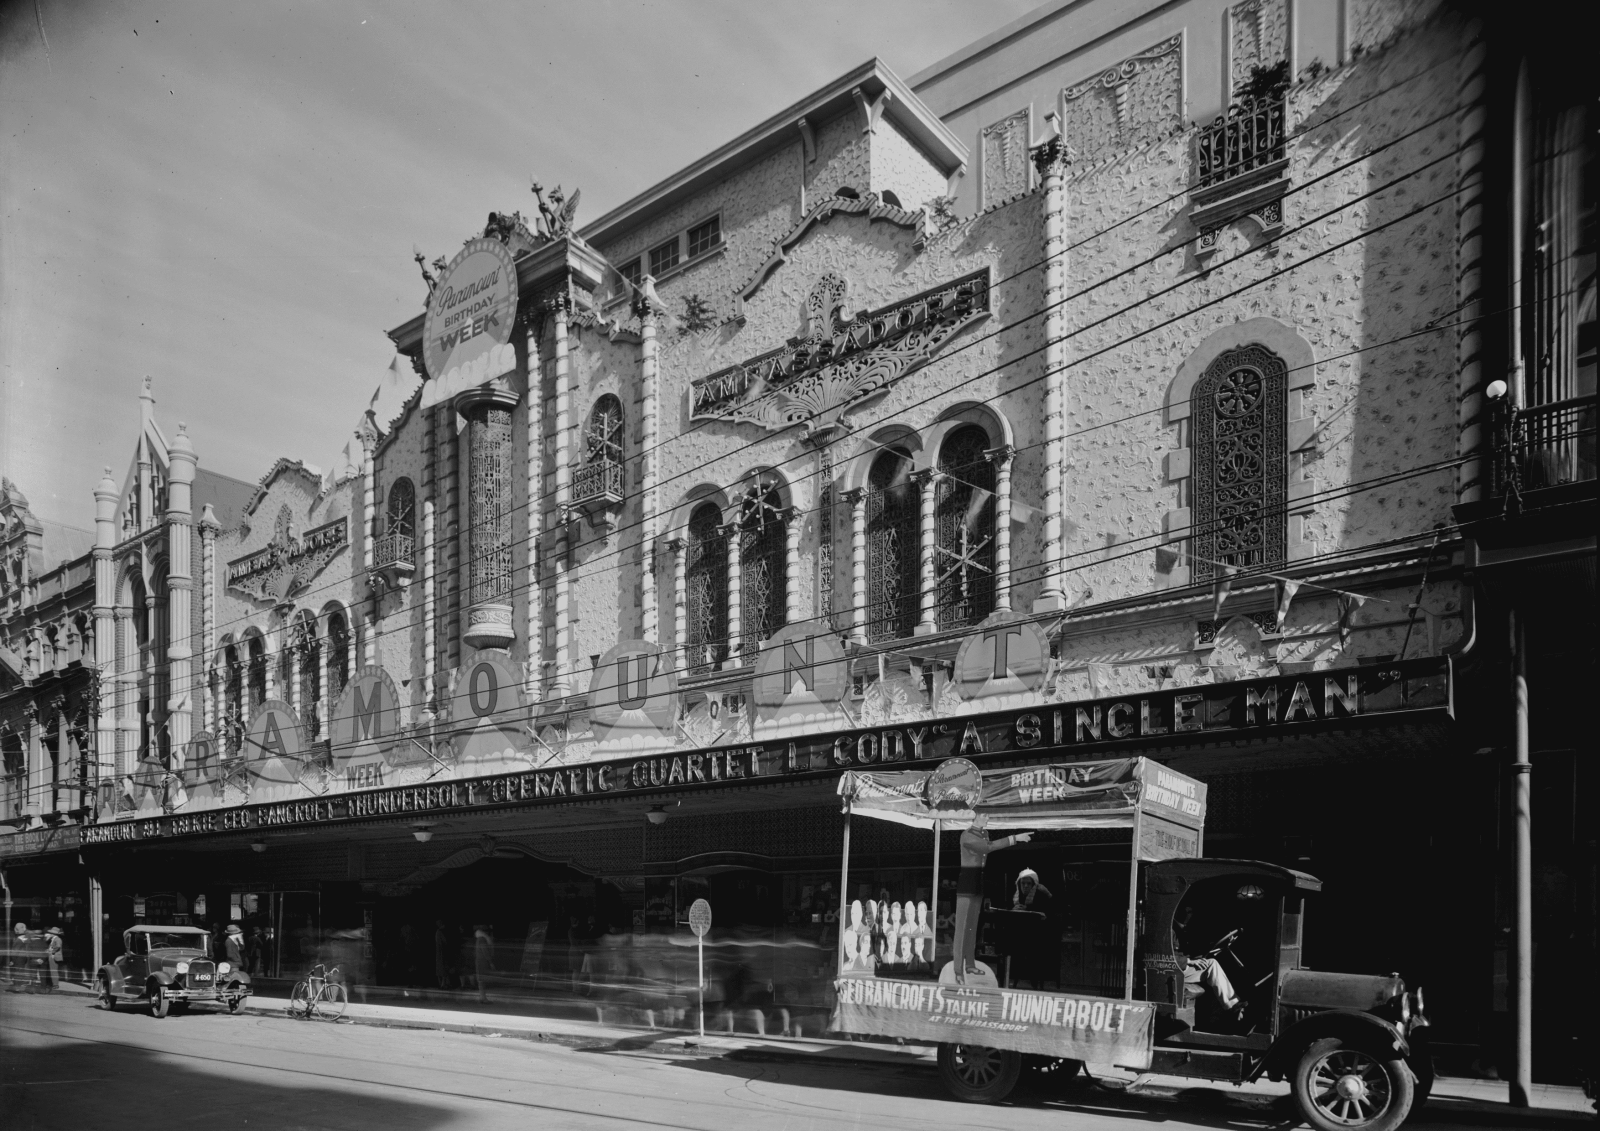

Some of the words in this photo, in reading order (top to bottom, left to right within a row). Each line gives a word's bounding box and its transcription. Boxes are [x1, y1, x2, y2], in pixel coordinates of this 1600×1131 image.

[436, 265, 502, 317] Paramount
[444, 293, 496, 328] BIRTHDAY
[439, 310, 500, 352] WEEK
[229, 526, 343, 580] AMBASADORS
[79, 823, 137, 844] PARAMOUNT
[492, 764, 613, 802] OPERATIC
[632, 745, 765, 788] QUARTET
[1015, 692, 1204, 748] SINGLE
[346, 761, 385, 790] WEEK
[1010, 766, 1094, 788] BIRTHDAY
[1018, 786, 1066, 804] WEEK
[1145, 783, 1181, 810] BIRTHDAY
[1181, 797, 1202, 817] WEEK
[838, 978, 864, 1005] GEO
[865, 980, 945, 1014] BANCROFTS
[946, 999, 989, 1018] TALKIE
[957, 987, 981, 997] ALL
[928, 1015, 940, 1023] AT
[944, 1017, 962, 1025] THE
[962, 1019, 1029, 1032] AMBASSADORS
